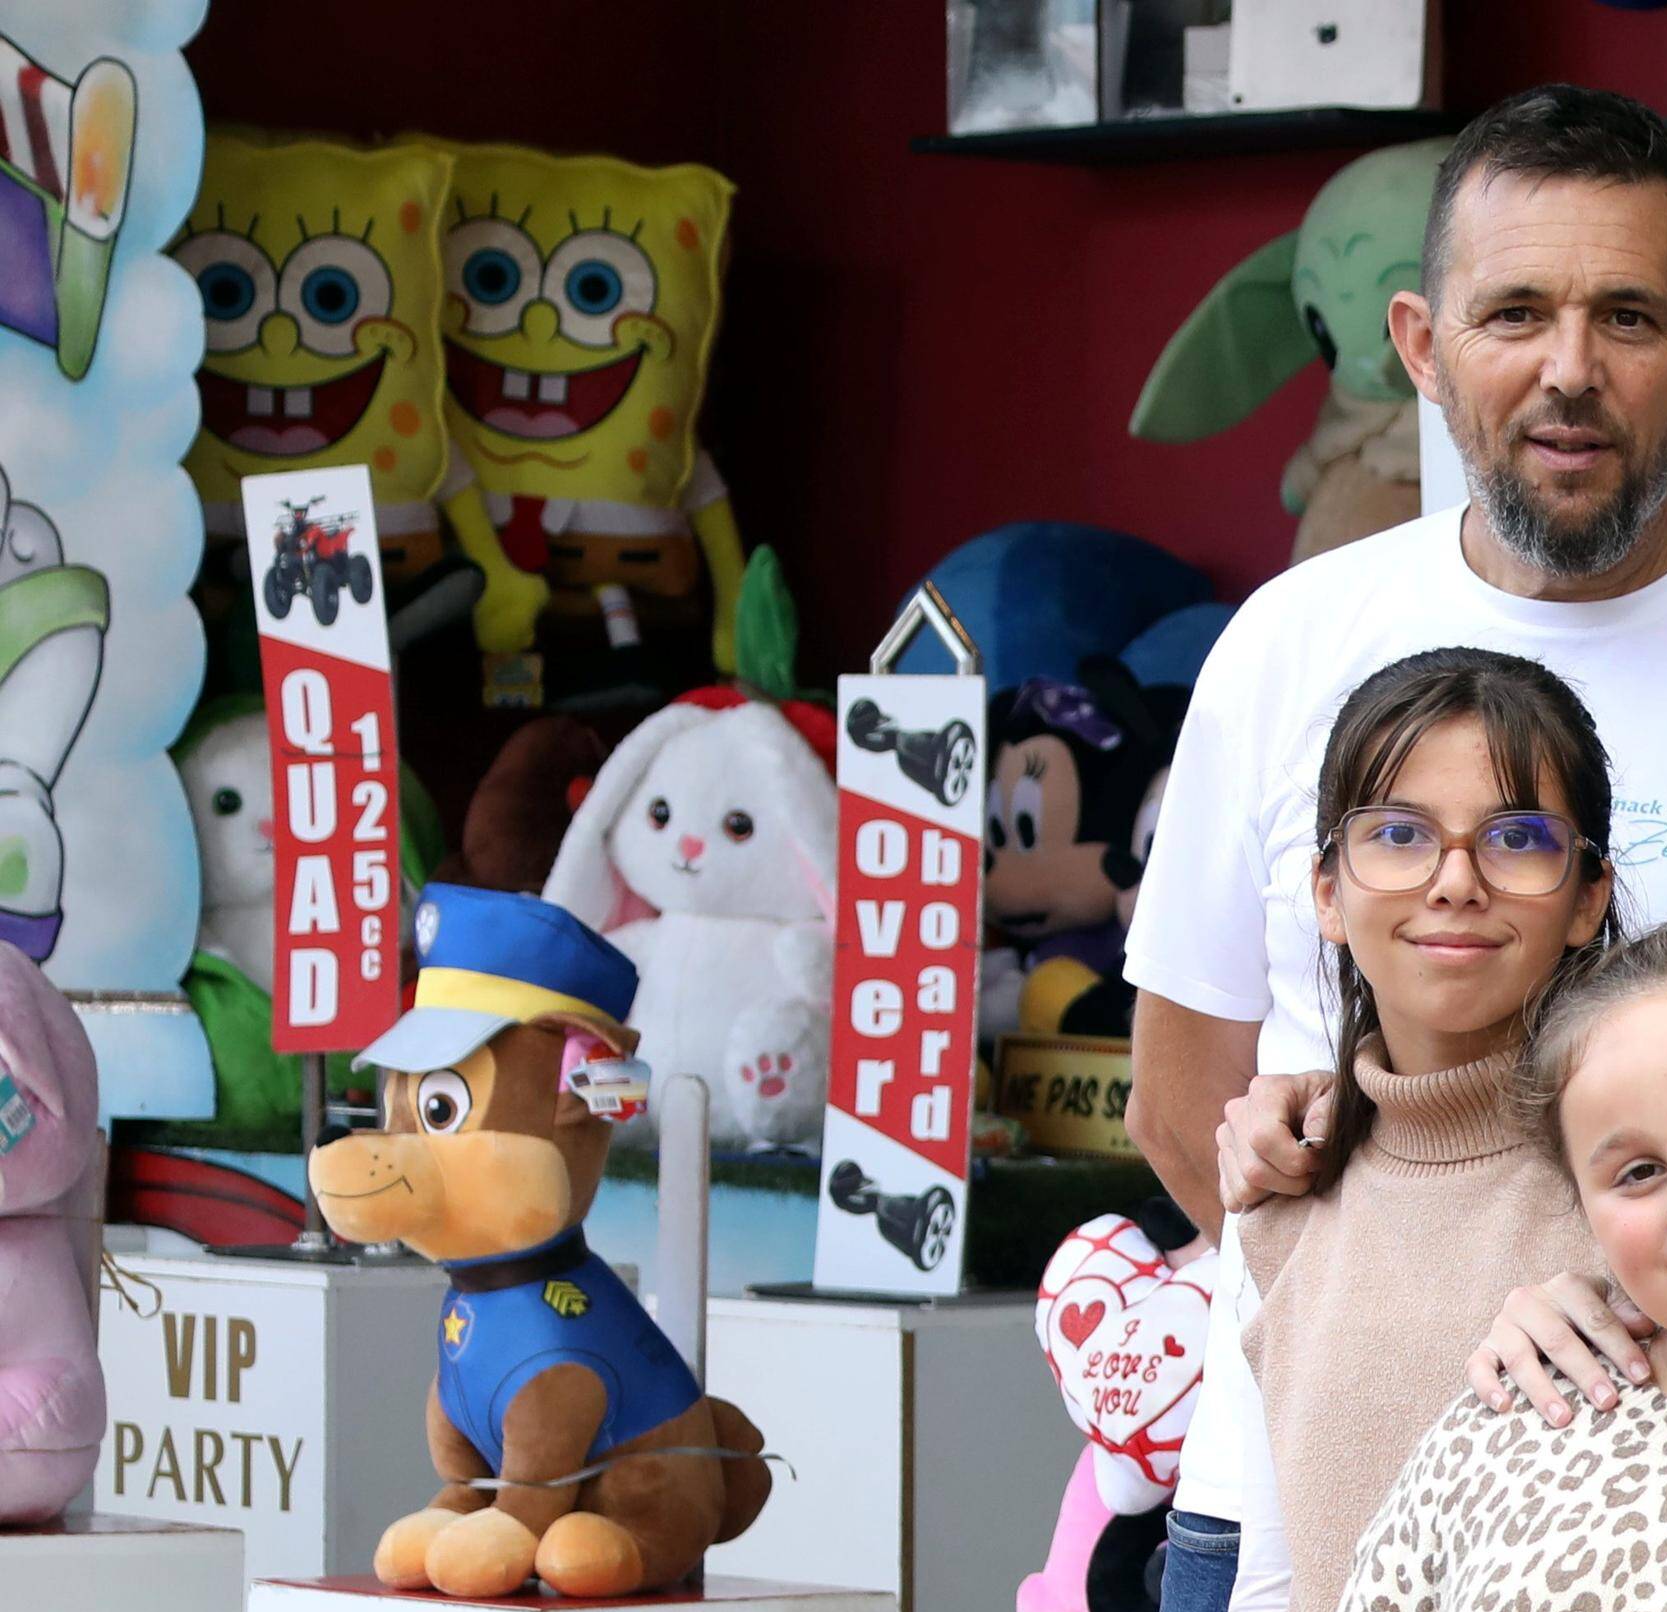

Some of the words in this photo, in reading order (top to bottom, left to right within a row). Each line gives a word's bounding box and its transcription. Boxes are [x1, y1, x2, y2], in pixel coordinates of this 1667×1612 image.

[1613, 798, 1663, 815] nack
[281, 667, 340, 1028] QUAD
[1045, 1073, 1099, 1118] PAS
[163, 1312, 257, 1404] VIP
[1082, 1353, 1163, 1383] LOVE
[1092, 1387, 1143, 1417] YOU
[112, 1420, 304, 1512] PARTY
